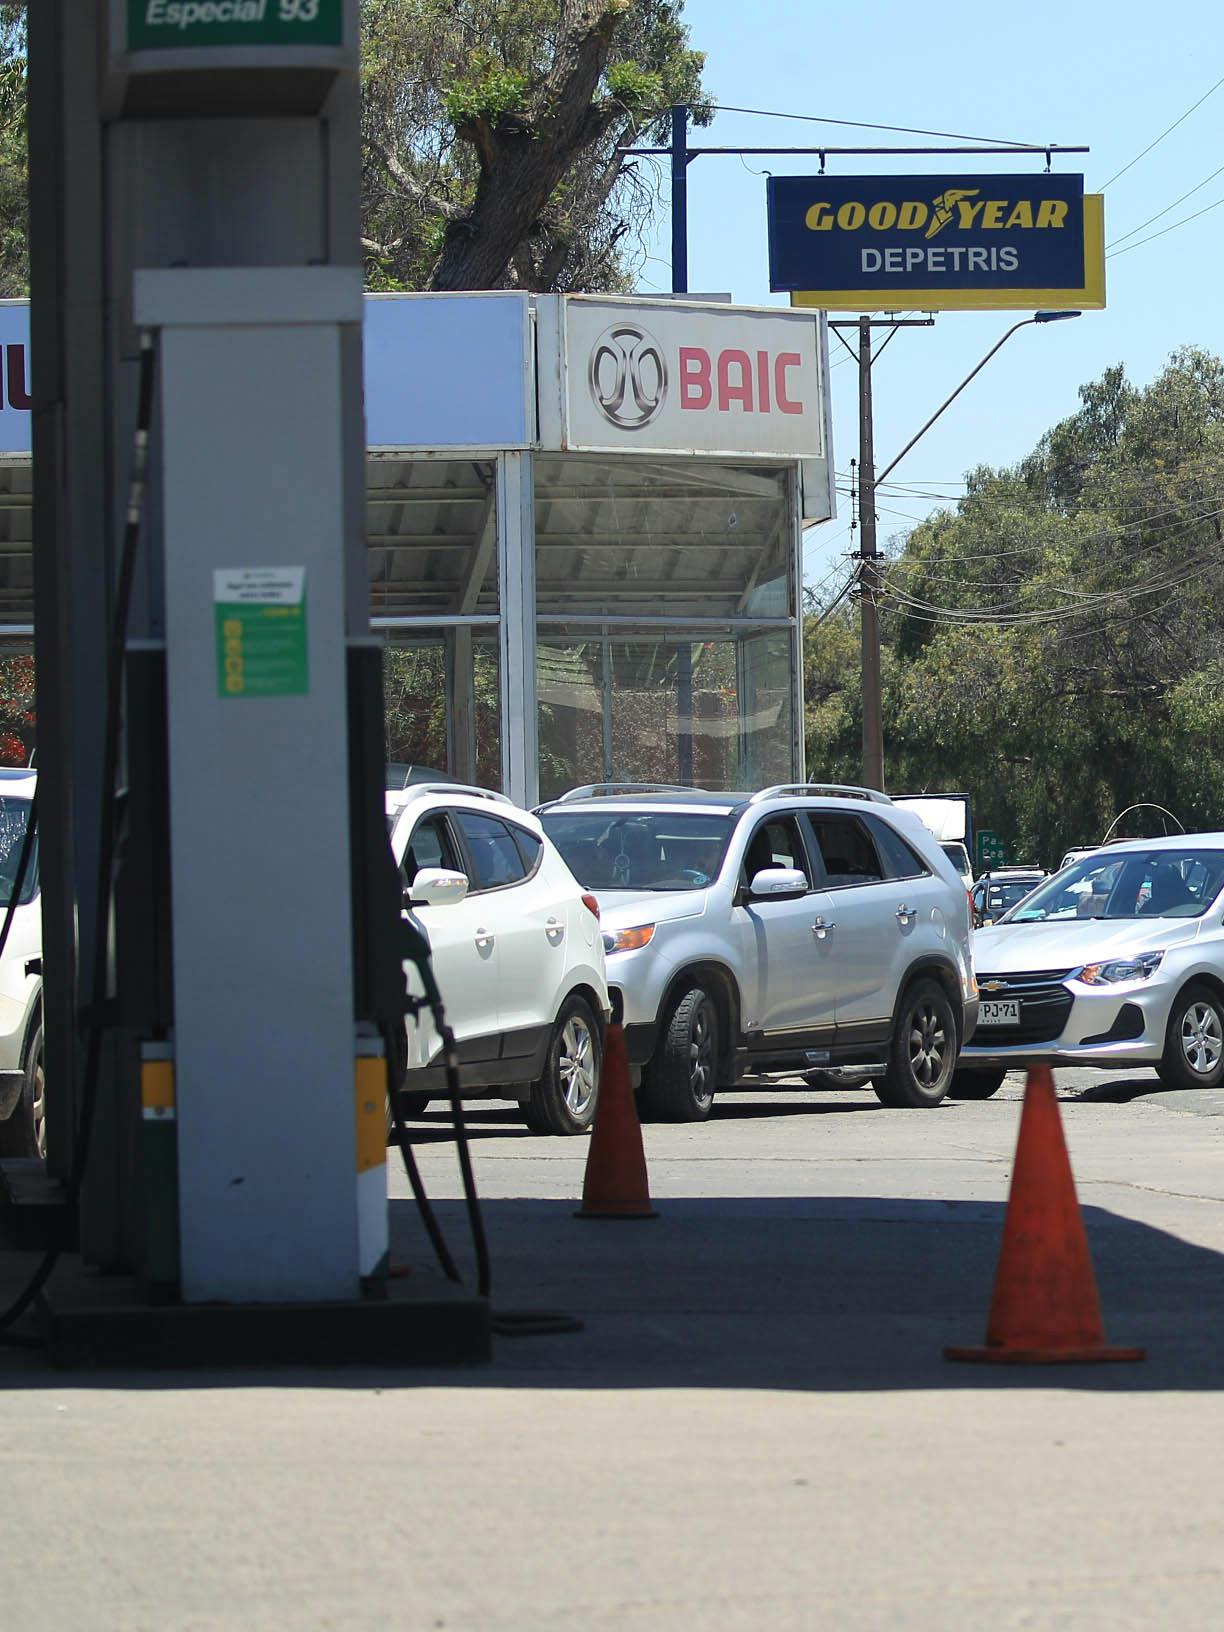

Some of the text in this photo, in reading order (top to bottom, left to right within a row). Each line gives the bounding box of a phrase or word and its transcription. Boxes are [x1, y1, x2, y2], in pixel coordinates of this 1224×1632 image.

[145, 0, 319, 29] Especial 93
[860, 246, 1019, 273] DEPETRIS
[678, 346, 804, 414] BAIC
